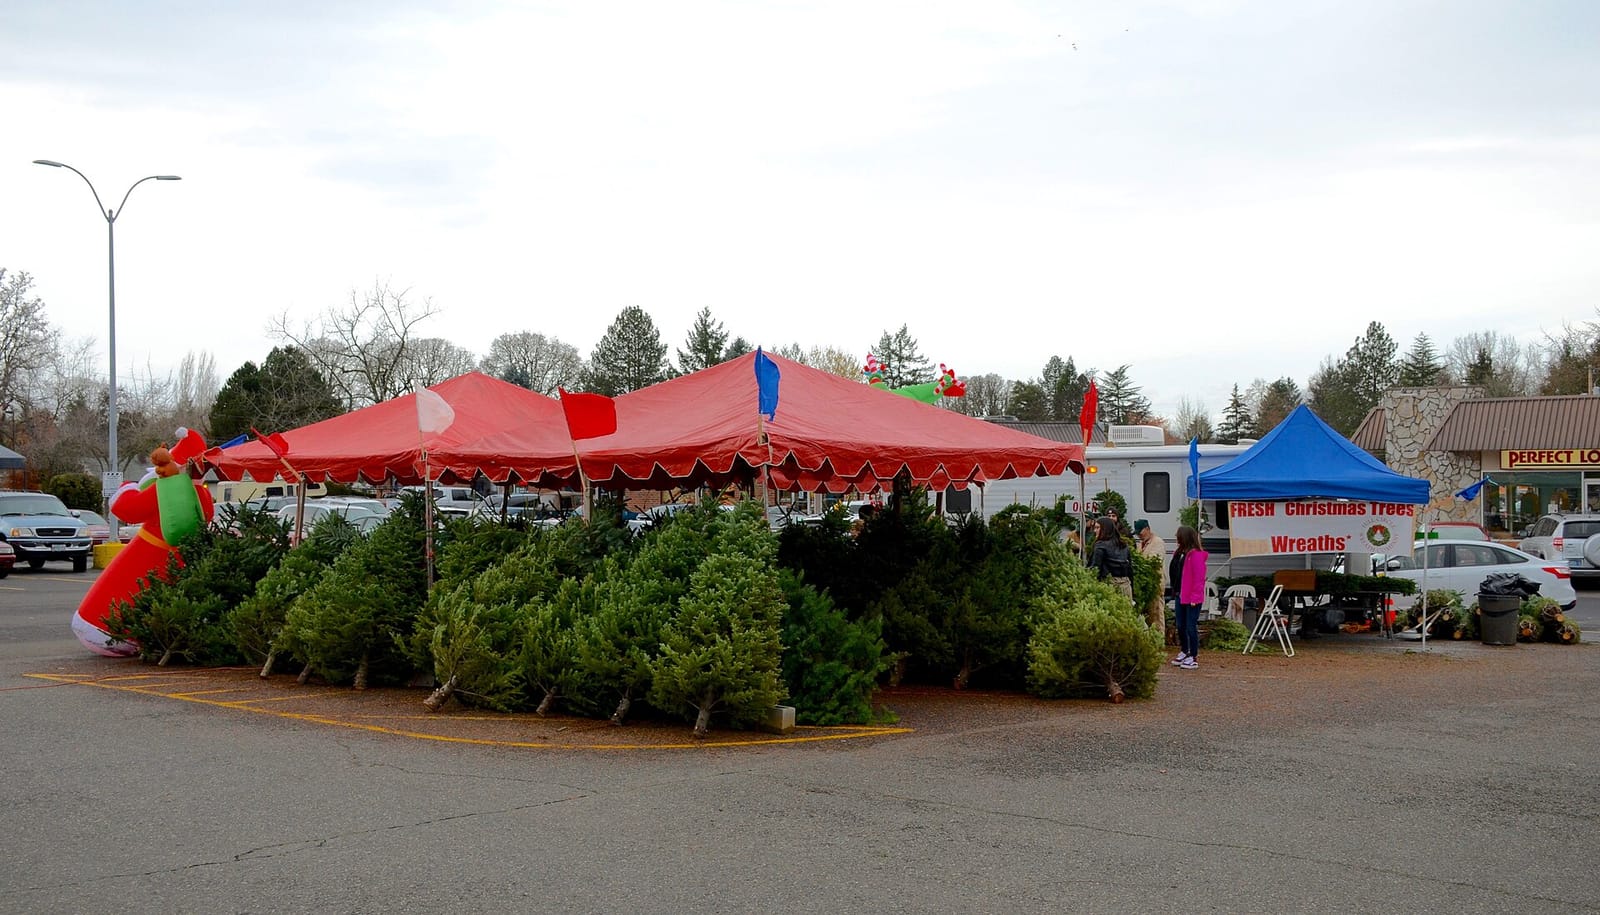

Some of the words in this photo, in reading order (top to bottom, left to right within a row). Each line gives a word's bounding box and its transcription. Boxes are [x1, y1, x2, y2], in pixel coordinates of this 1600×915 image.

[1509, 450, 1574, 468] PERFECT
[1073, 502, 1098, 513] OEN
[1231, 502, 1275, 518] FRESH
[1285, 502, 1366, 516] Christmas
[1369, 502, 1414, 517] Trees
